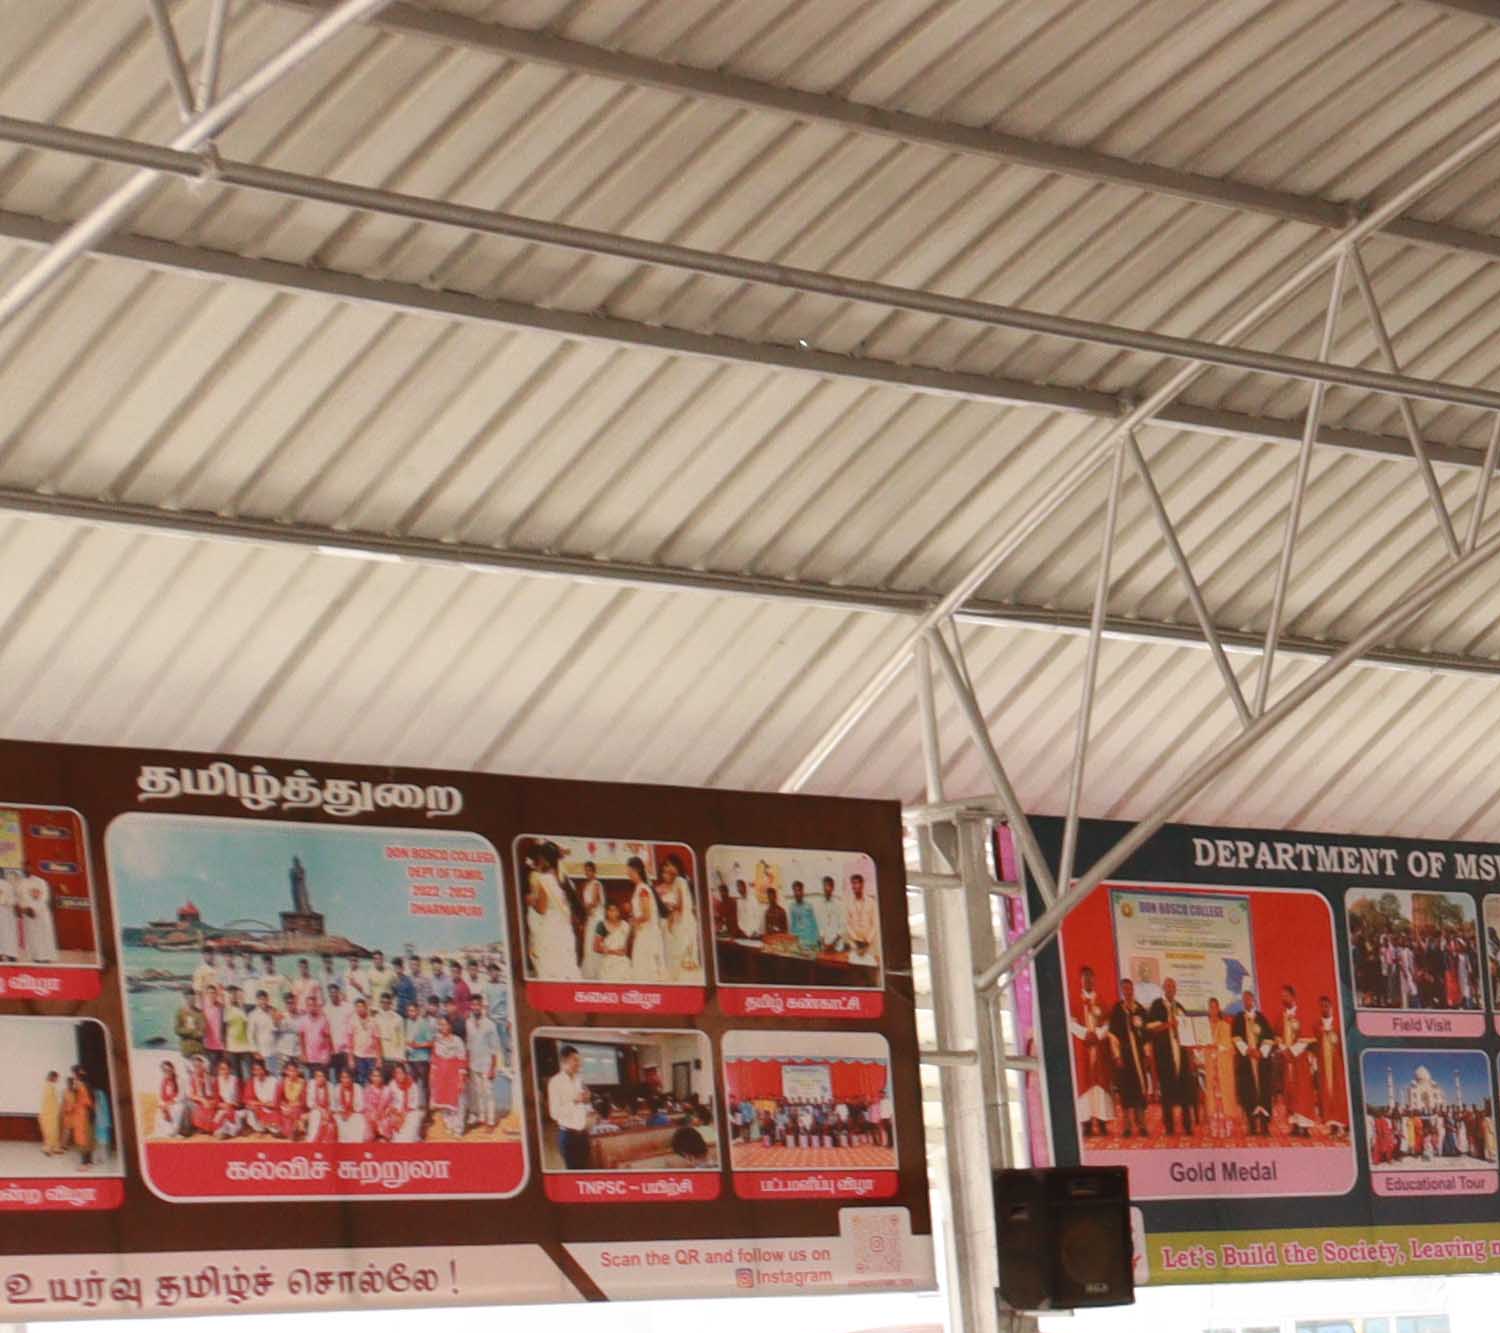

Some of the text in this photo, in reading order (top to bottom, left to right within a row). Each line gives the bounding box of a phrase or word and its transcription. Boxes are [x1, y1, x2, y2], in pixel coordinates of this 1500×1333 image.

[137, 761, 464, 817] தமிழ்த்துறை
[1192, 837, 1398, 877] DEPARTMENT
[1406, 851, 1446, 880] OF
[1392, 1017, 1453, 1033] Field Visit
[226, 1152, 451, 1188] கல்விச் சுற்றுலா
[1169, 1160, 1278, 1183] Gold Medal
[576, 1179, 627, 1195] TNPSC
[1385, 1176, 1487, 1192] Educational Tour
[600, 1246, 831, 1268] Scan the QR and follow us on
[1222, 1242, 1278, 1268] Build
[1284, 1242, 1318, 1266] the
[1323, 1237, 1406, 1268] Society,
[1410, 1238, 1488, 1263] Leaving
[5, 1268, 143, 1313] உயர்வு
[155, 1264, 276, 1307] தமிழ்ச்
[288, 1262, 440, 1296] சொல்லே
[756, 1267, 833, 1288] Instagram
